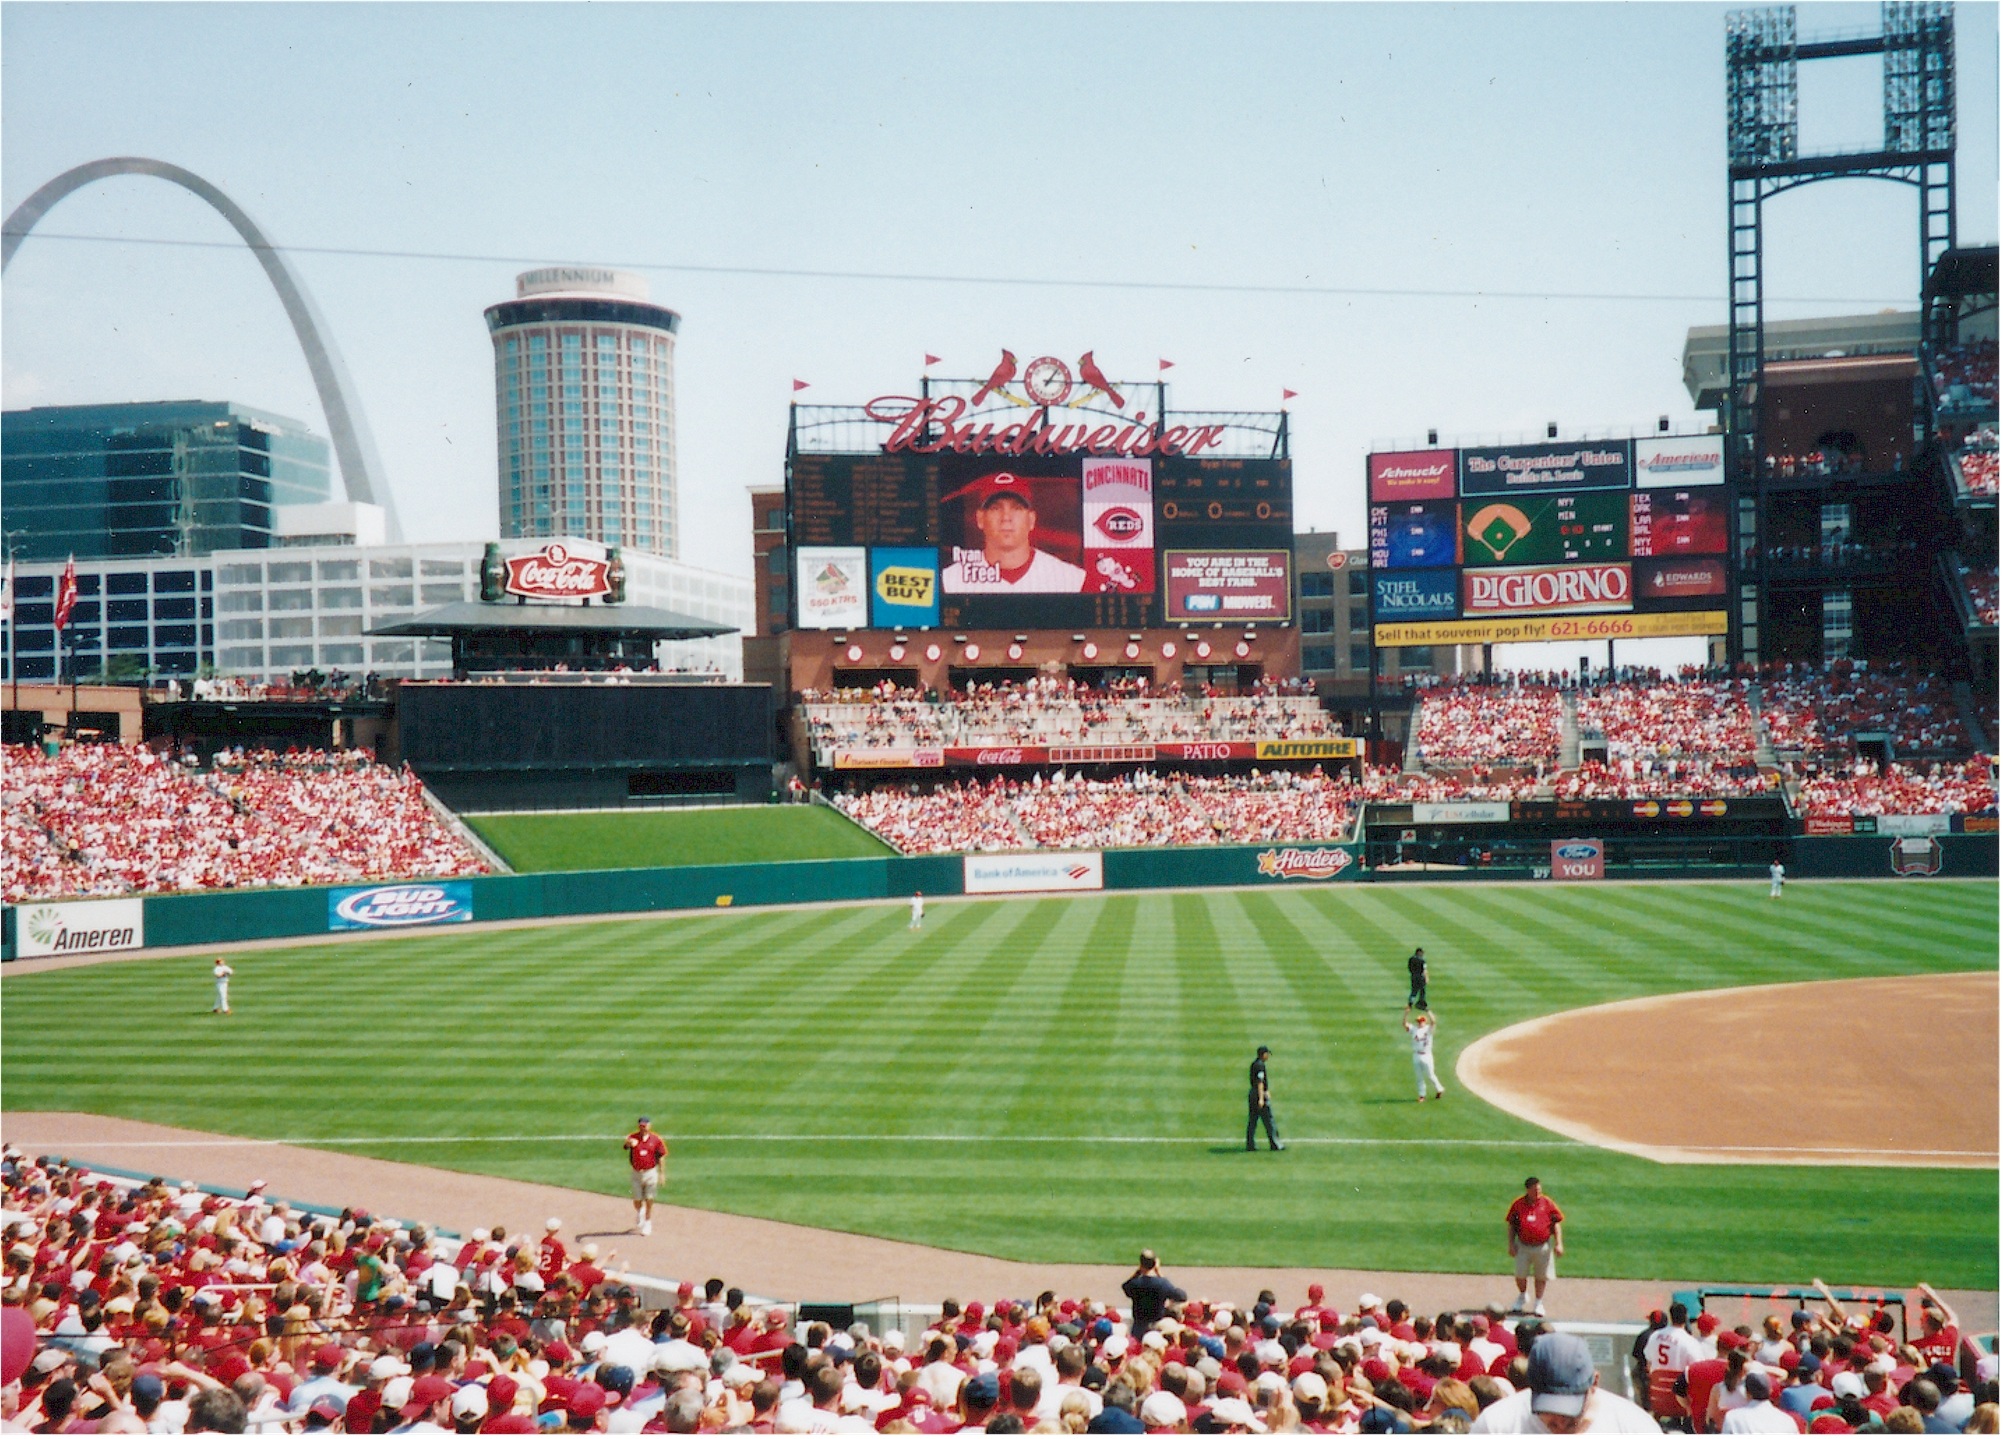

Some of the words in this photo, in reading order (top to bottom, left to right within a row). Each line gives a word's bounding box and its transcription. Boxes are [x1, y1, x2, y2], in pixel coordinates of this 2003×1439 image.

[865, 395, 1224, 456] Budweiser
[1468, 458, 1496, 472] The
[1581, 451, 1624, 467] Union
[1638, 452, 1721, 468] American
[1086, 465, 1149, 492] CINCINNATI
[1378, 464, 1448, 479] Schnucks
[1163, 502, 1178, 519] 0
[1207, 502, 1222, 519] 0
[1256, 502, 1271, 519] 0
[1109, 520, 1142, 530] REDS
[952, 546, 983, 564] Ryan
[1187, 557, 1209, 567] YOU
[1211, 557, 1232, 567] ARE
[1234, 557, 1245, 567] IN
[1247, 557, 1269, 566] THE
[885, 574, 932, 587] BEST
[963, 563, 1000, 583] Freel
[1172, 568, 1204, 577] HOME
[1205, 568, 1219, 577] OF
[1666, 571, 1712, 582] EDWARDS
[1199, 578, 1225, 587] BEST
[1377, 580, 1419, 595] STIFEL
[1472, 567, 1627, 607] DIGIORNO
[886, 587, 927, 599] BUY
[1383, 592, 1455, 608] NICOLAUS
[1377, 629, 1401, 641] Sell
[1405, 627, 1431, 640] that
[1436, 626, 1491, 638] souvenir
[1495, 626, 1520, 638] pop
[1524, 623, 1546, 637] fly!
[1551, 620, 1633, 636] 621-6666
[1184, 745, 1230, 759] PATIO
[1262, 742, 1350, 757] AUTOTIRE
[974, 868, 1000, 879] Bank
[1002, 867, 1013, 877] of
[1015, 866, 1057, 877] America
[1562, 864, 1595, 876] YOU
[371, 889, 444, 905] BUD
[356, 900, 457, 919] LIGHT
[53, 927, 133, 951] Ameren
[1658, 1344, 1670, 1365] 5
